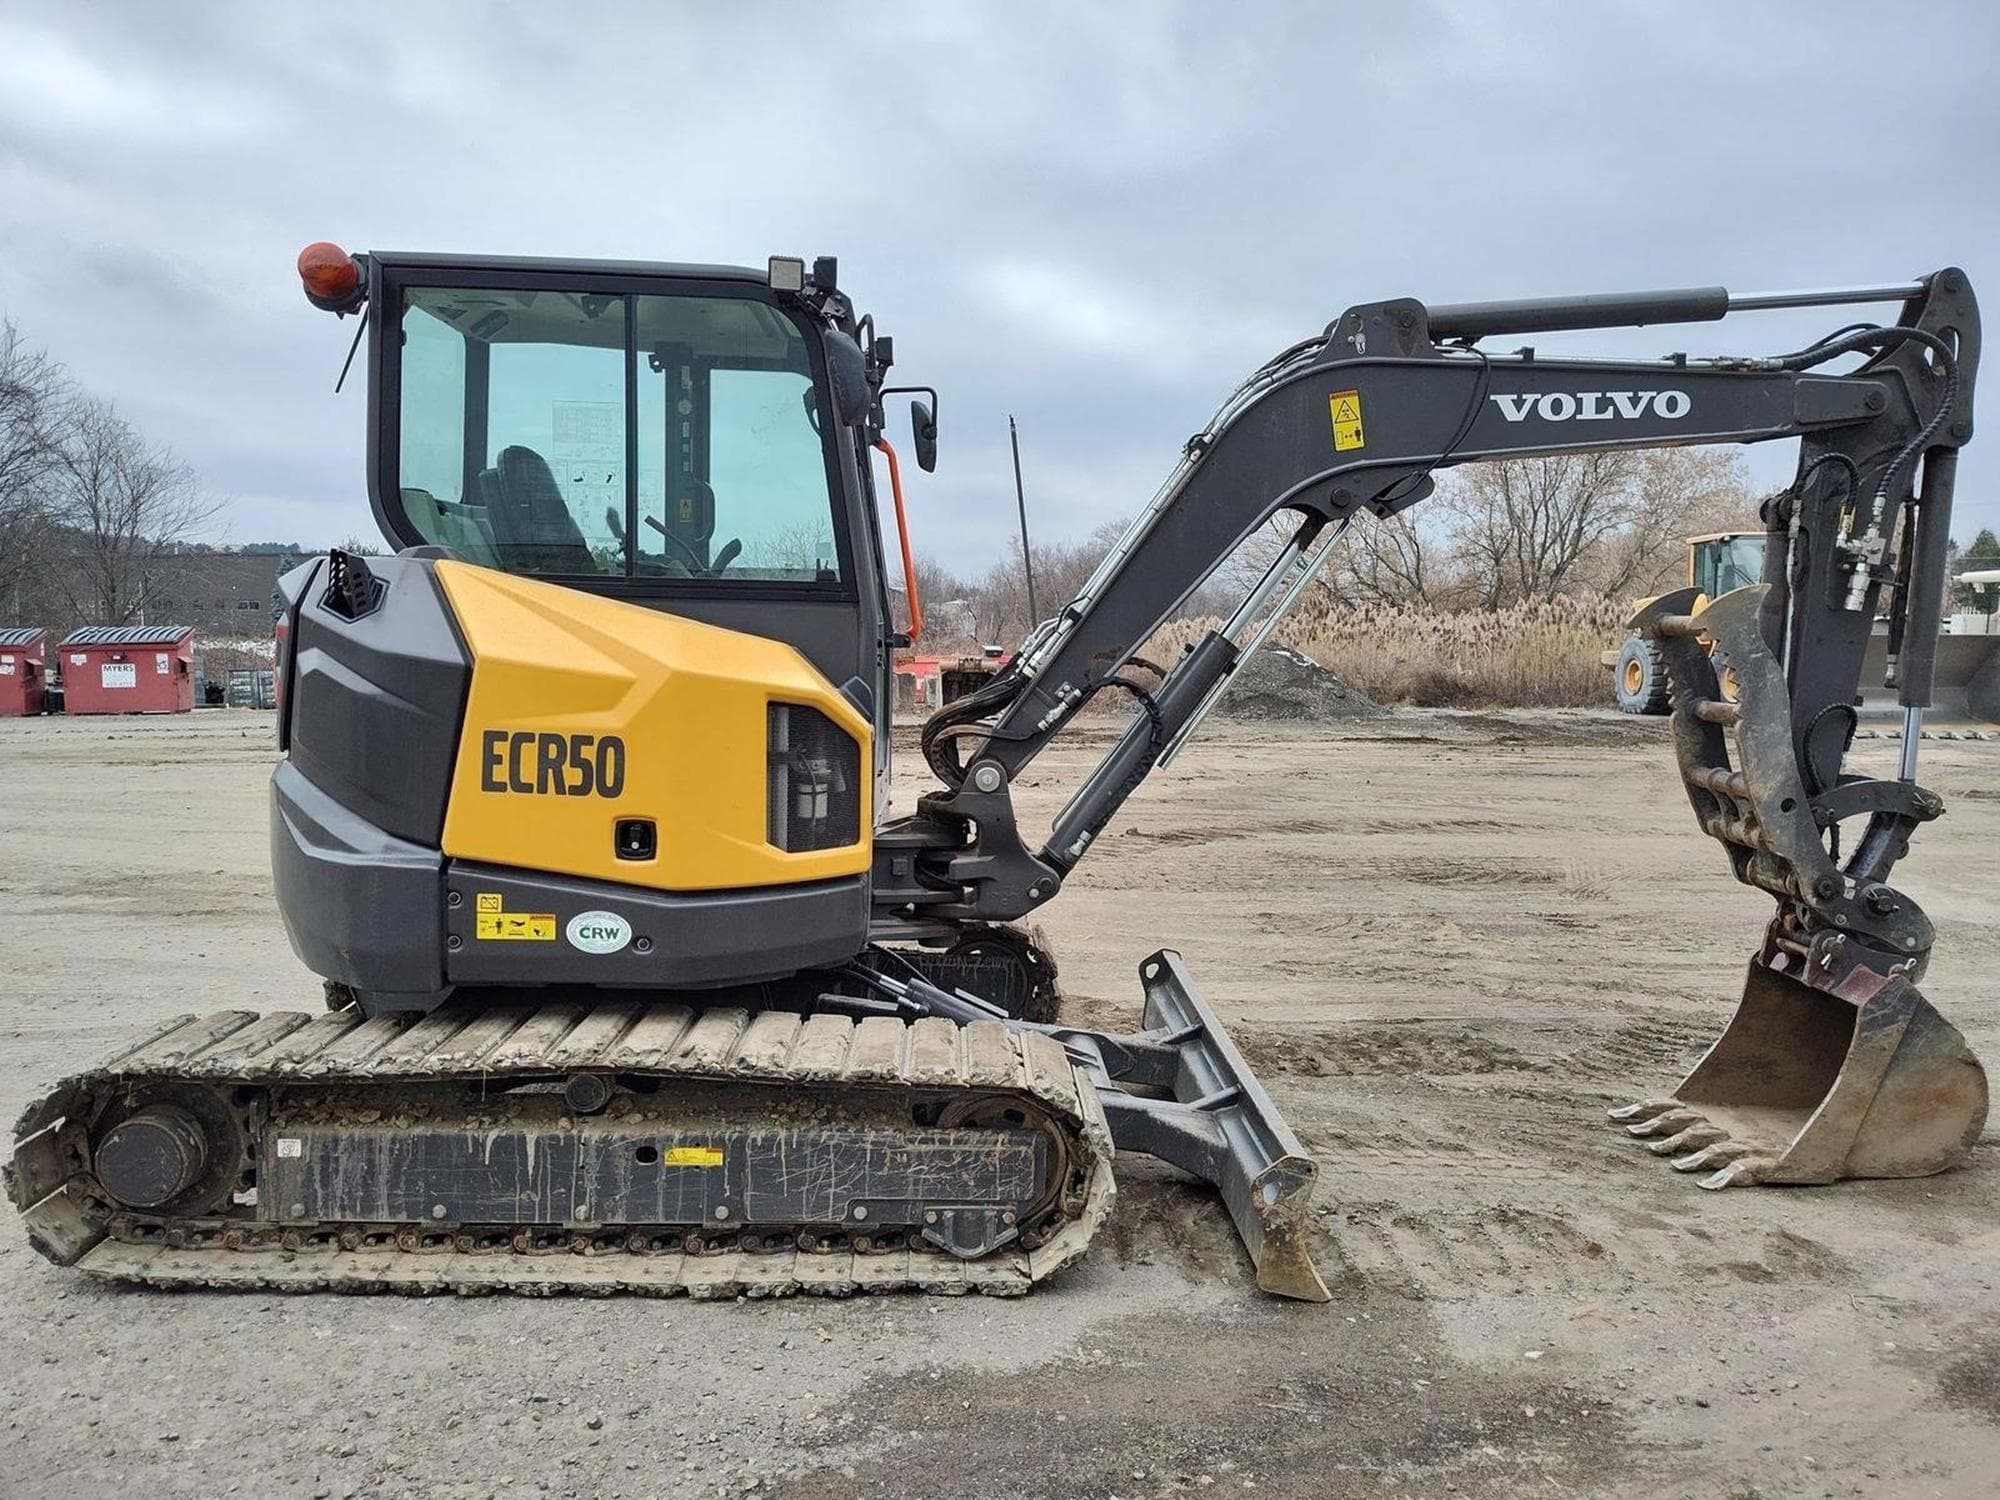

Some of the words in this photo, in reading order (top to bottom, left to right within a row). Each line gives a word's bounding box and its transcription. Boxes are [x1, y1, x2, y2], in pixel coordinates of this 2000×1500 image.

[1490, 390, 1691, 422] VOLVO
[481, 730, 626, 798] ECR50
[579, 927, 620, 940] CRW
